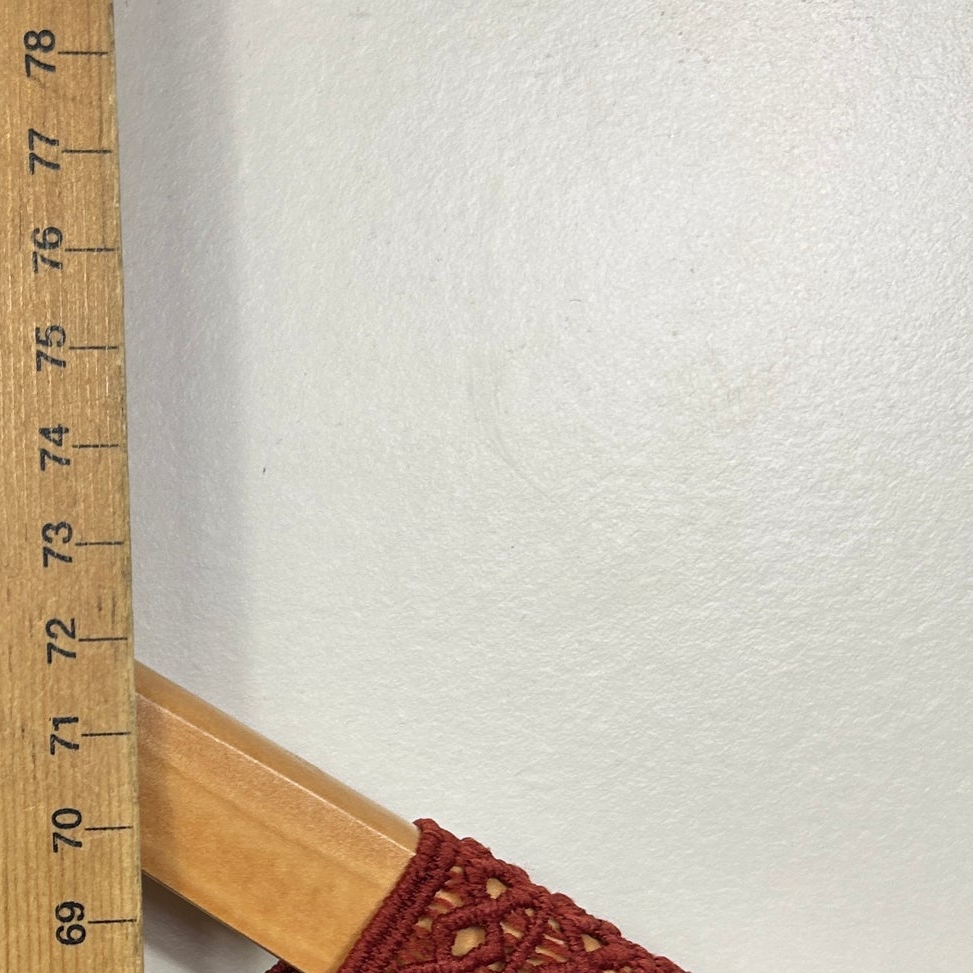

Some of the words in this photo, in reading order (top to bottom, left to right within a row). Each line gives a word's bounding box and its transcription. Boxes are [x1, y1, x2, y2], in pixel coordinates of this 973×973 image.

[23, 29, 56, 78] 78
[28, 128, 60, 176] 77
[32, 226, 63, 273] 76
[35, 323, 68, 372] 75
[38, 423, 71, 472] 74
[41, 521, 73, 568] 73
[45, 617, 77, 665] 72
[49, 716, 80, 756] 71
[51, 807, 83, 854] 70
[54, 901, 87, 946] 69
